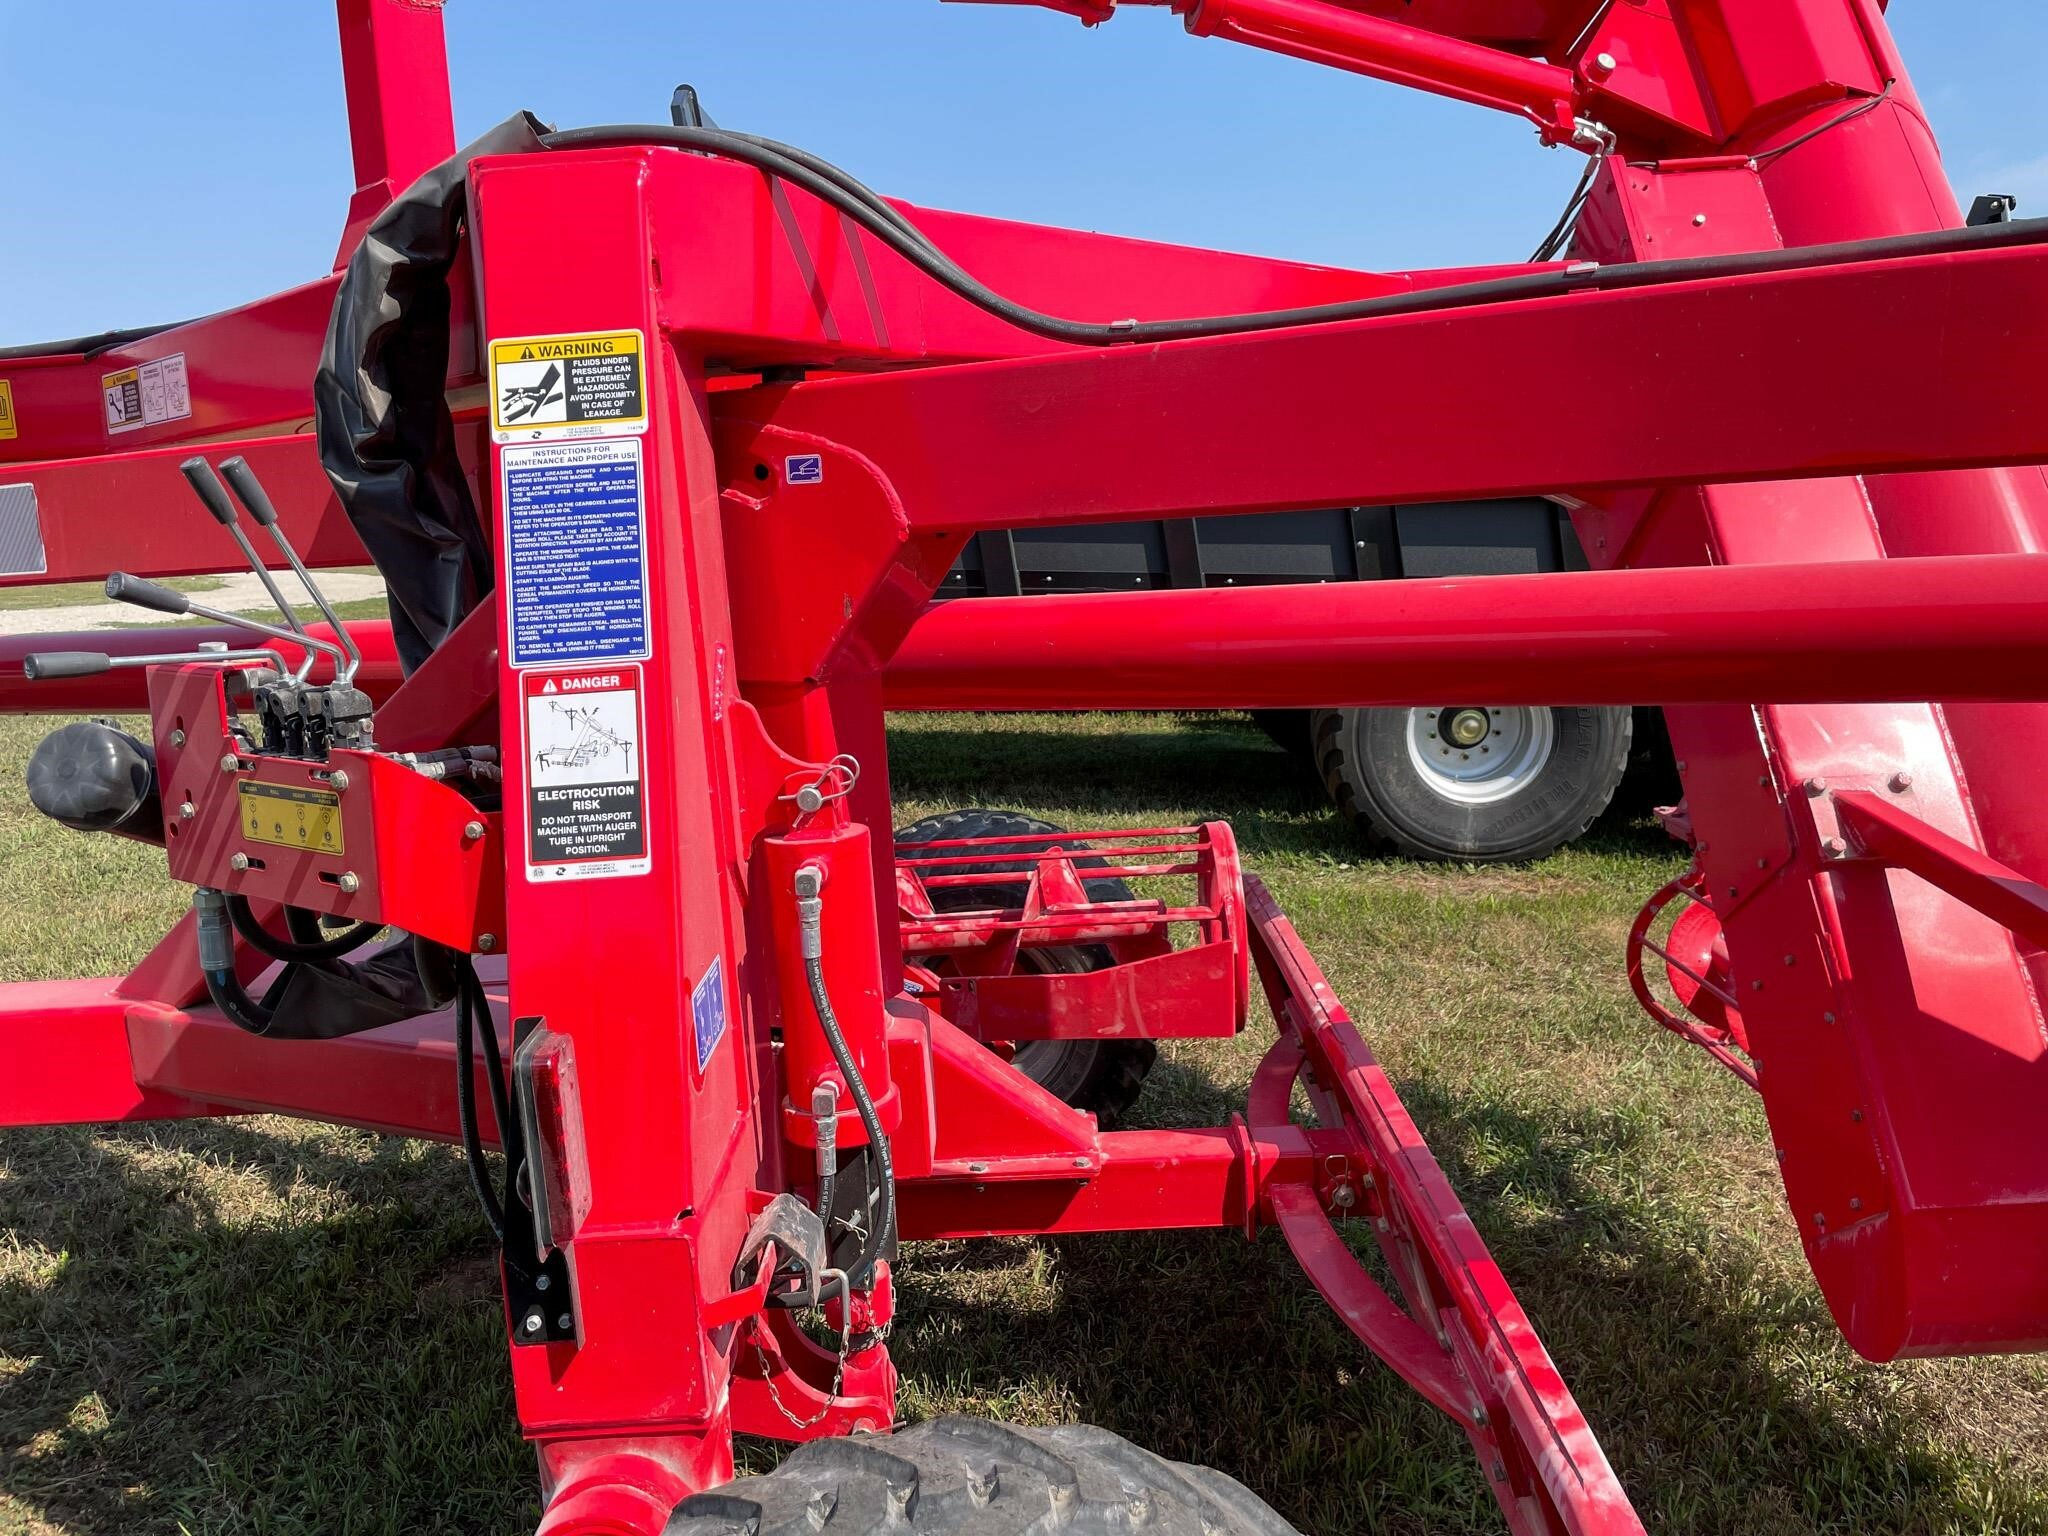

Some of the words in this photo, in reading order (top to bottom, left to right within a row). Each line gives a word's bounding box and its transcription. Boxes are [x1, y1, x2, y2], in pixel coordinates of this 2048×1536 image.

[538, 340, 613, 357] WARNING
[572, 358, 600, 367] FLUIDS
[601, 356, 628, 365] UNDER
[571, 365, 612, 375] PRESSURE
[614, 364, 630, 372] CAN
[585, 373, 630, 383] EXTREMELY
[577, 382, 627, 392] HAZARDOUS.
[569, 393, 593, 401] AVOID
[594, 390, 635, 399] PROXIMITY
[590, 400, 612, 408] CASE
[584, 408, 622, 417] LEAKAGE.
[532, 446, 591, 456] INSTRUCTIONS
[506, 456, 564, 466] MAINTENANCE
[586, 453, 618, 461] PROPER
[562, 675, 619, 690] DANGER
[537, 784, 634, 801] ELECTROCUTION
[572, 799, 600, 810] RISK
[541, 816, 554, 825] DO
[556, 815, 575, 824] NOT
[577, 810, 632, 822] TRANSPORT
[537, 825, 578, 836] MACHINE
[580, 823, 602, 833] WITH
[604, 821, 636, 831] AUGER
[548, 836, 572, 846] TUBE
[575, 835, 584, 844] IN
[586, 832, 625, 843] UPRIGHT
[565, 843, 609, 855] POSITION.
[851, 1070, 859, 1081] R17
